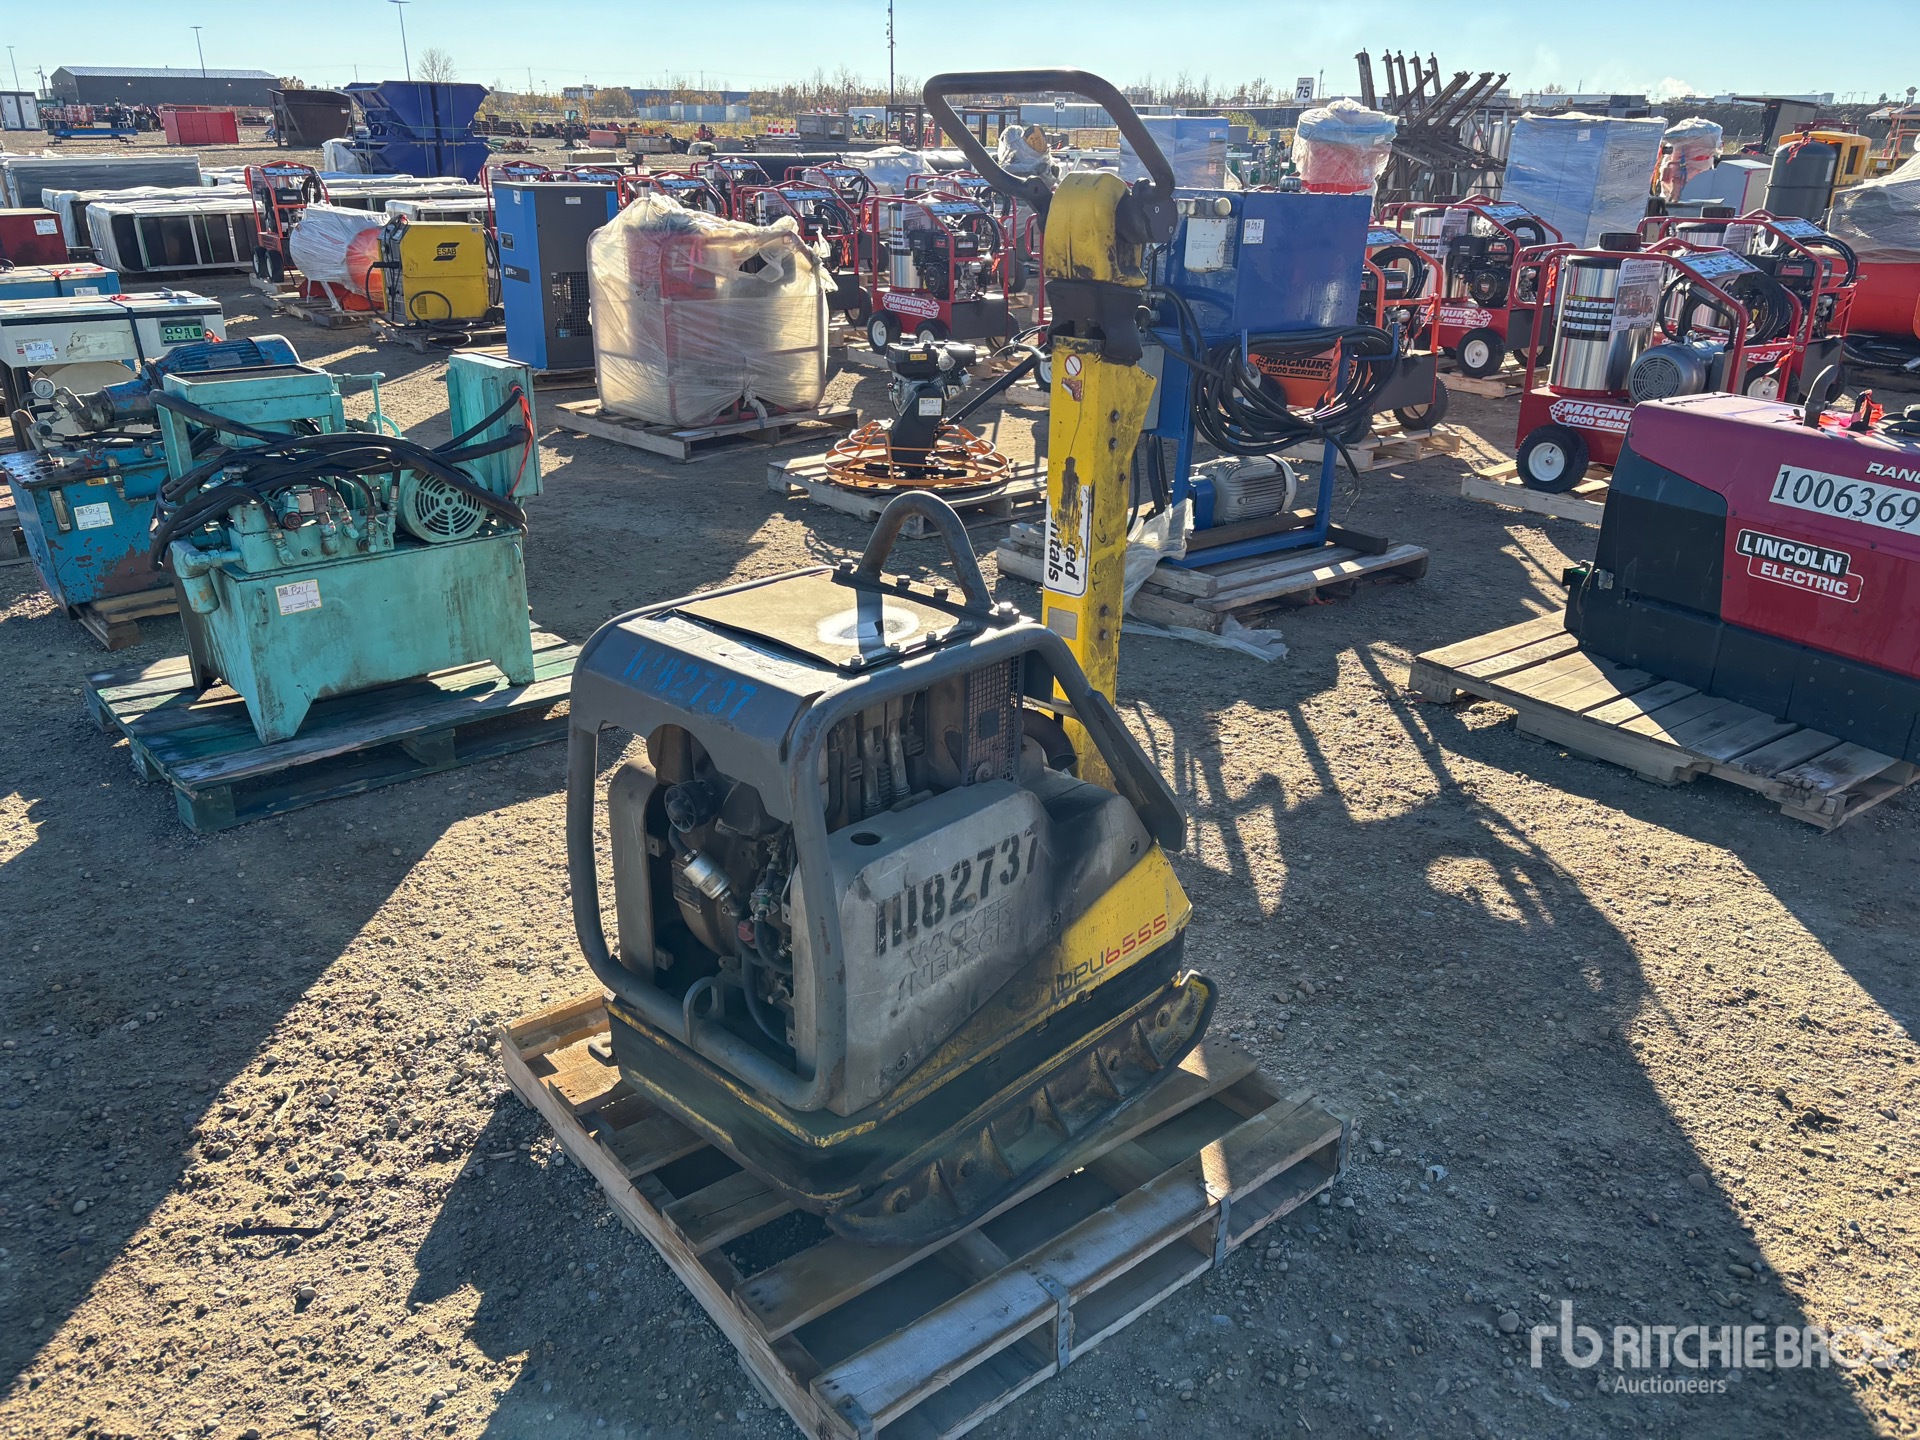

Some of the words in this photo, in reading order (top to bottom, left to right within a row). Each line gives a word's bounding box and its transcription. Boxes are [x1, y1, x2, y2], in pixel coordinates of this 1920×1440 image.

[1297, 87, 1310, 98] 75
[437, 248, 457, 256] ESAB
[887, 295, 924, 307] MAGNUM
[1266, 358, 1328, 370] MAGNUM
[1267, 366, 1287, 374] 4000
[1288, 368, 1323, 377] SERIES
[1566, 415, 1595, 426] 4000
[1773, 470, 1920, 527] 1006369
[1742, 534, 1843, 575] LINCOLN
[1760, 561, 1849, 596] ELECTRIC
